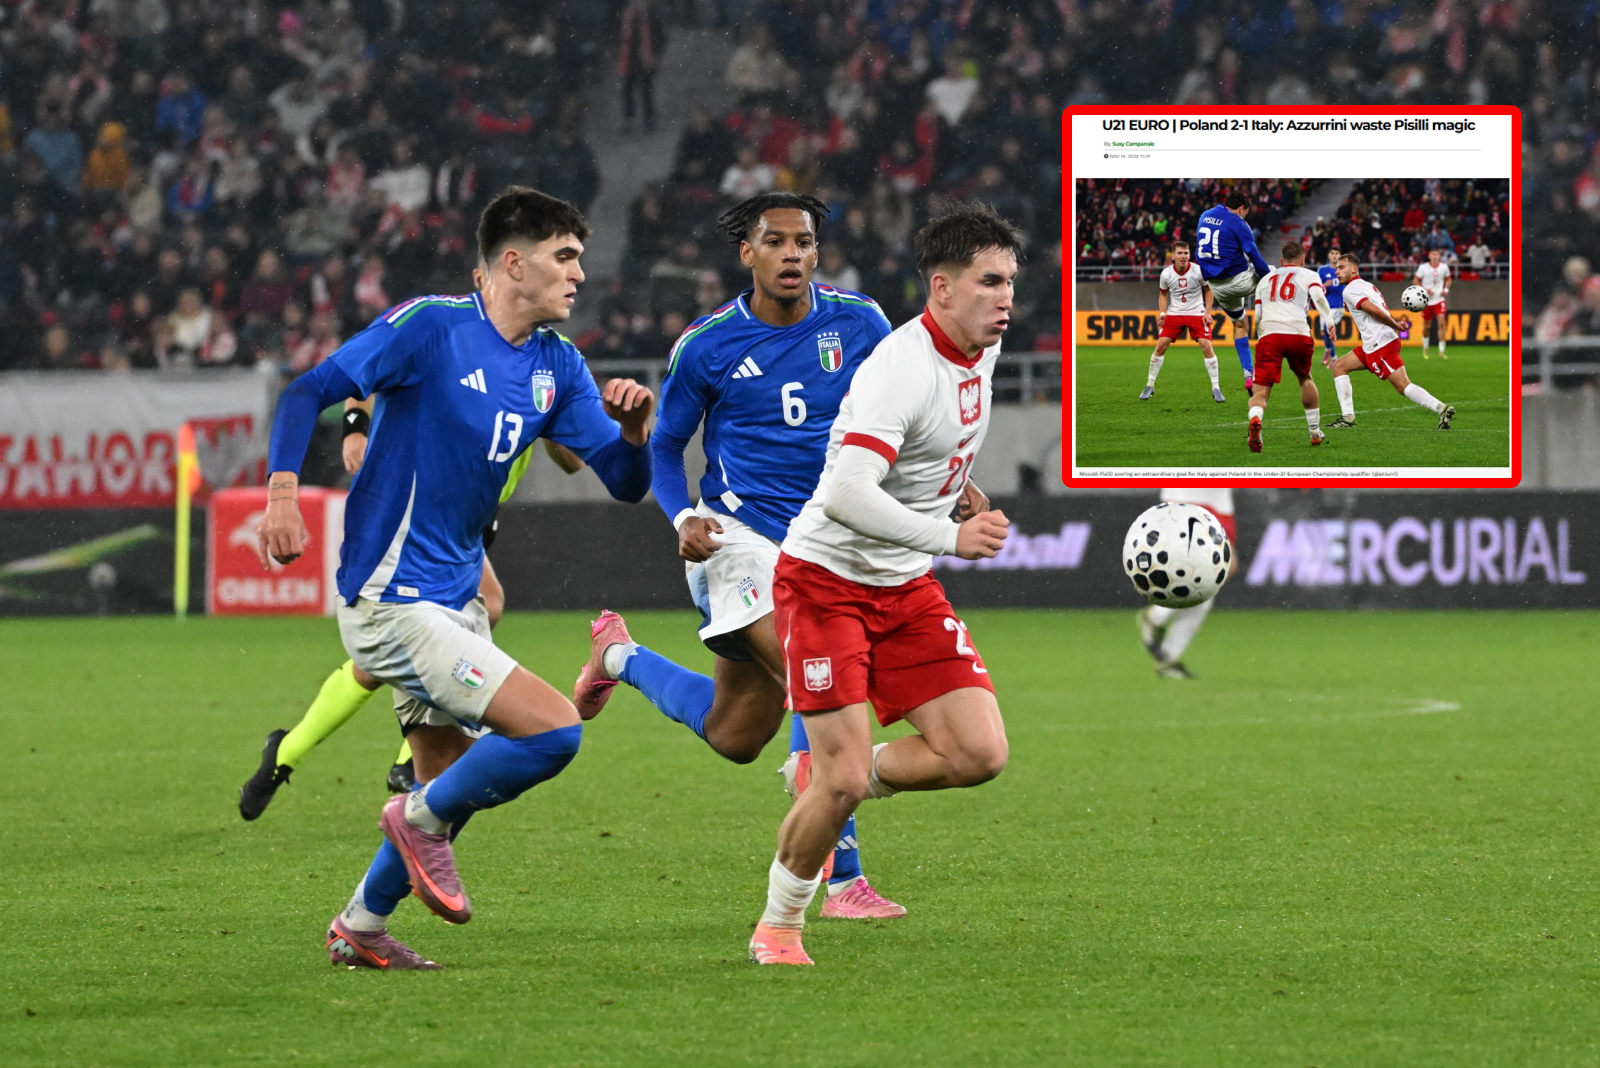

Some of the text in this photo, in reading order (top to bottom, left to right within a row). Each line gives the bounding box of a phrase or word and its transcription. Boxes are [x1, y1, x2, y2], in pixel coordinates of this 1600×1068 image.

[1202, 216, 1223, 226] PISILLI
[1197, 226, 1221, 259] 21
[1180, 292, 1188, 303] 6
[1268, 272, 1297, 303] 16
[819, 339, 839, 350] ITALIA
[534, 377, 553, 387] ITALIA
[781, 381, 807, 427] 6
[487, 410, 523, 463] 13
[1245, 517, 1587, 586] MERCURIAL
[219, 577, 319, 606] ORLEN
